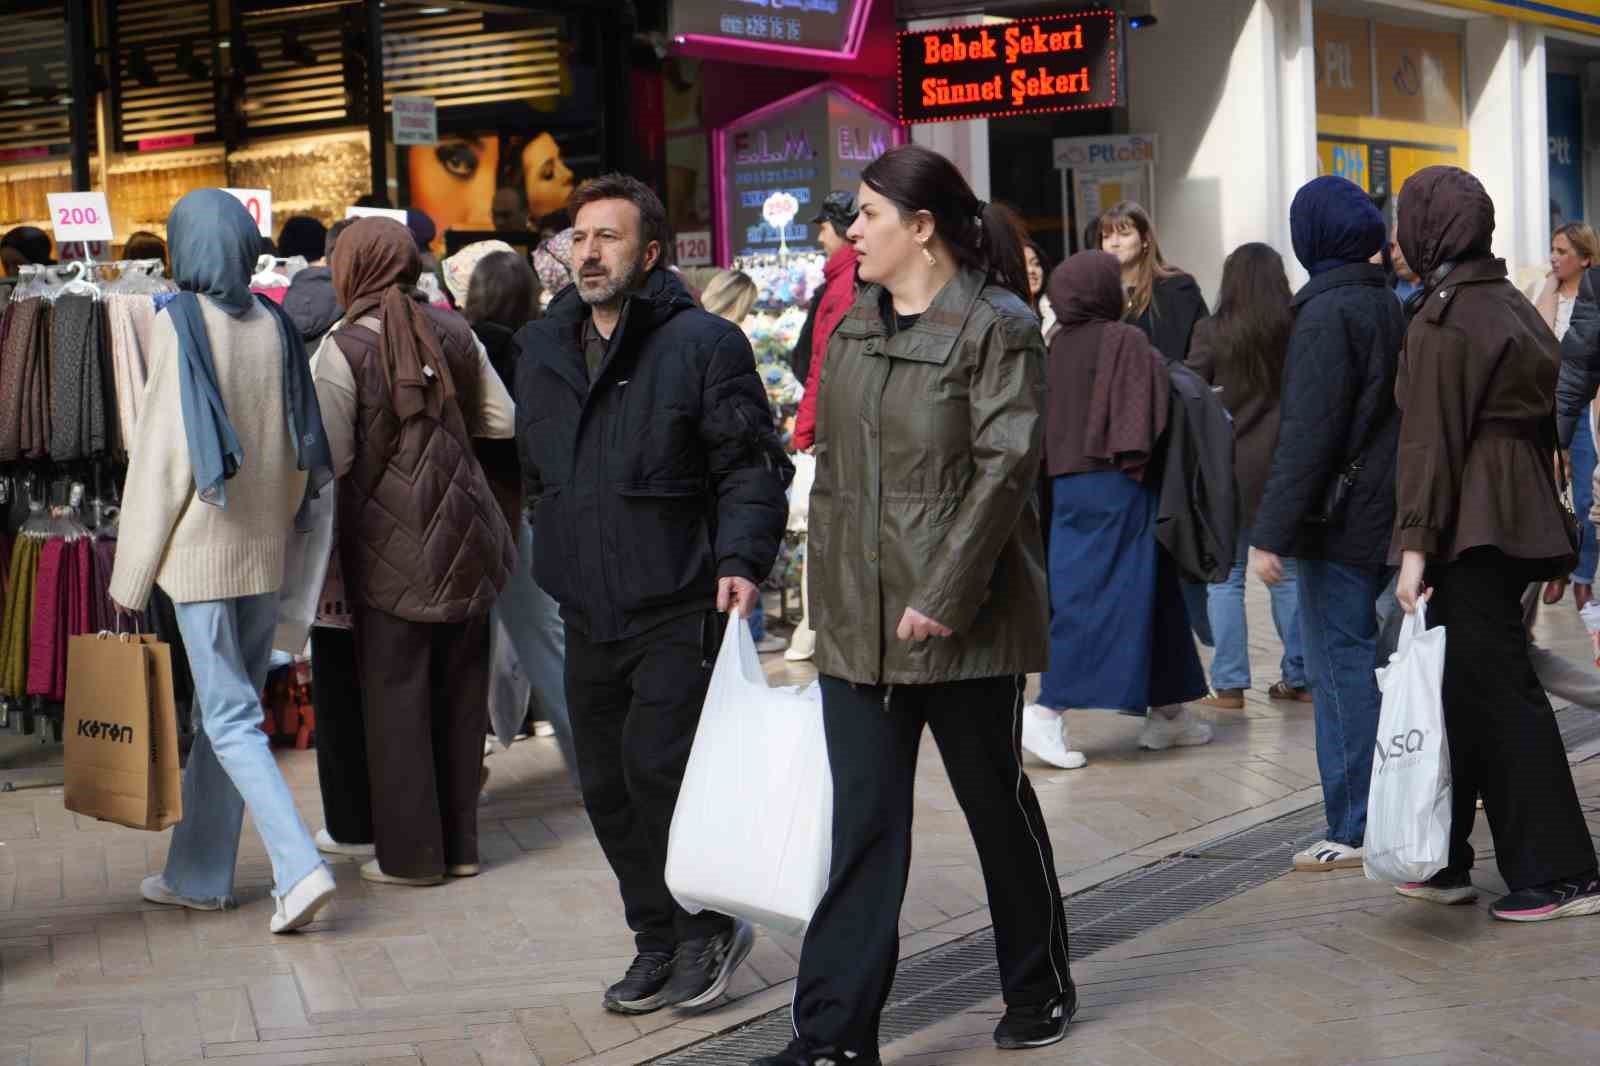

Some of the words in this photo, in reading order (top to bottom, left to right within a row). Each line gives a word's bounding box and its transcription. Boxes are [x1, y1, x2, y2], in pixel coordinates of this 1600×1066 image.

[923, 30, 997, 65] Bebek
[1004, 24, 1084, 64] Şekeri
[922, 75, 1003, 107] Sünnet
[1010, 66, 1090, 106] Şekeri
[675, 239, 707, 258] 120
